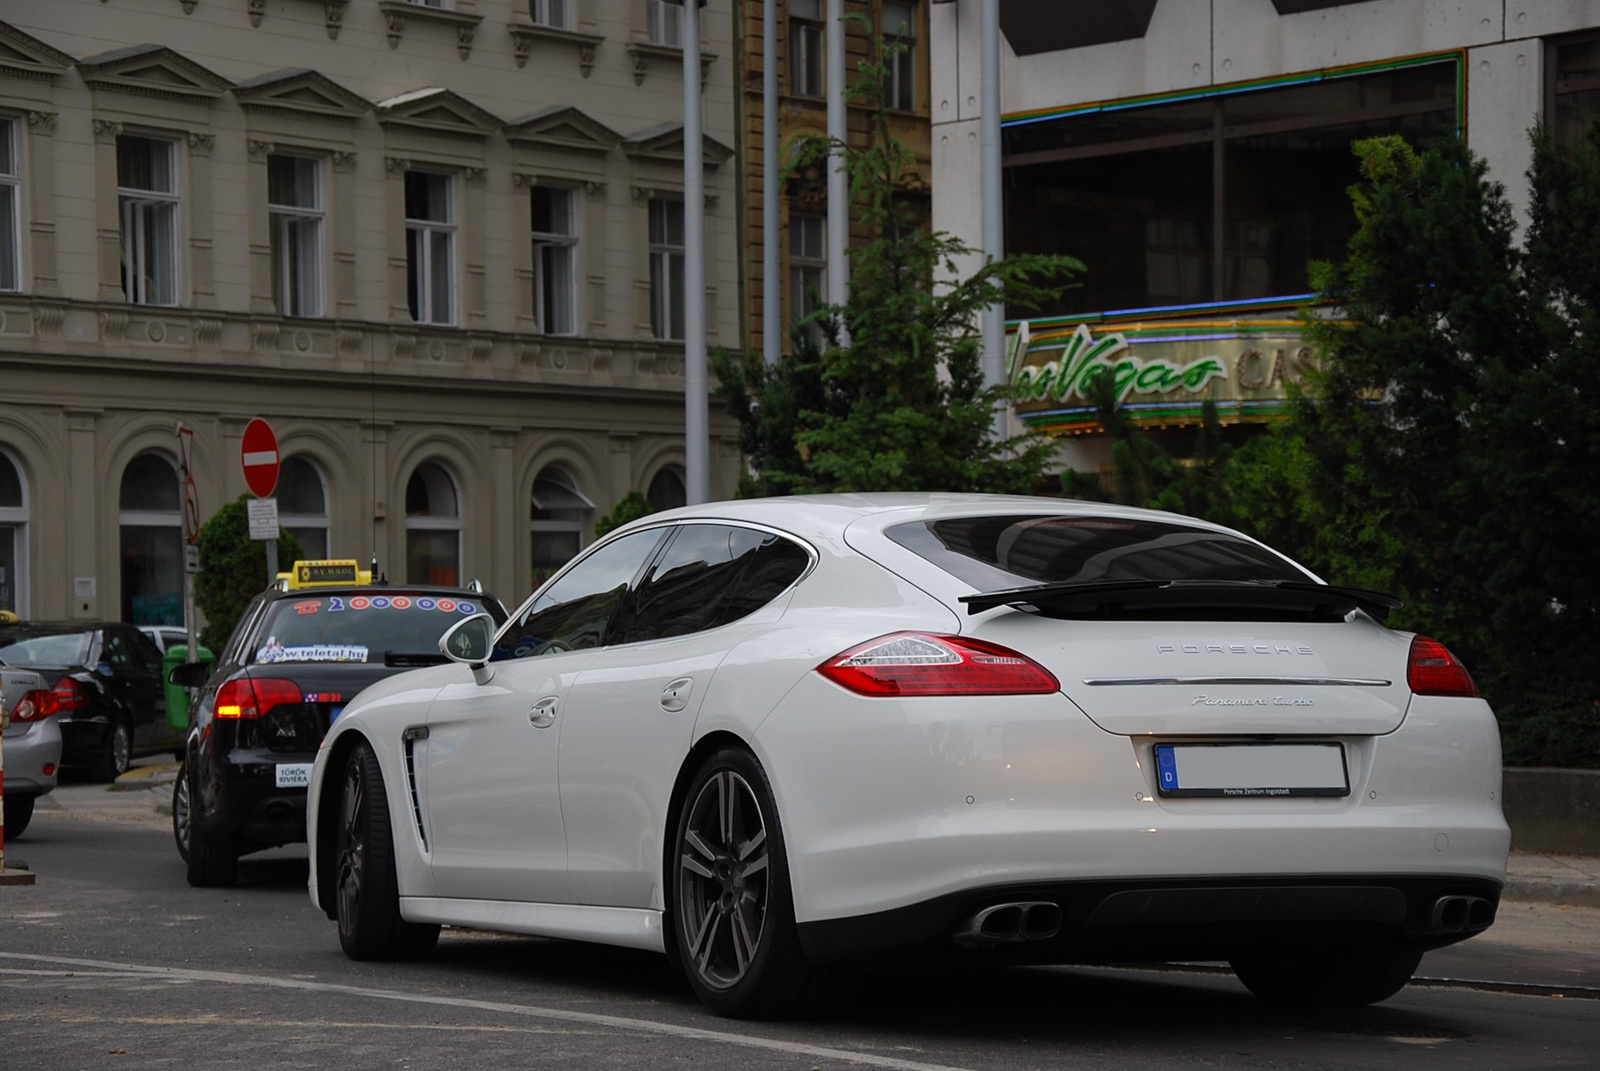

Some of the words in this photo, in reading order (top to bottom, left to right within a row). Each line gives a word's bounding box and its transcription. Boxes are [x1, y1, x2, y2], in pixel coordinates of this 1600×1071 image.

[1052, 324, 1228, 408] Vegas
[328, 597, 345, 612] 2
[1157, 644, 1314, 656] PORSCHE
[1191, 695, 1268, 706] Panamera
[276, 728, 296, 737] A4
[1165, 772, 1173, 782] D
[1265, 788, 1290, 796] Ingolstadt
